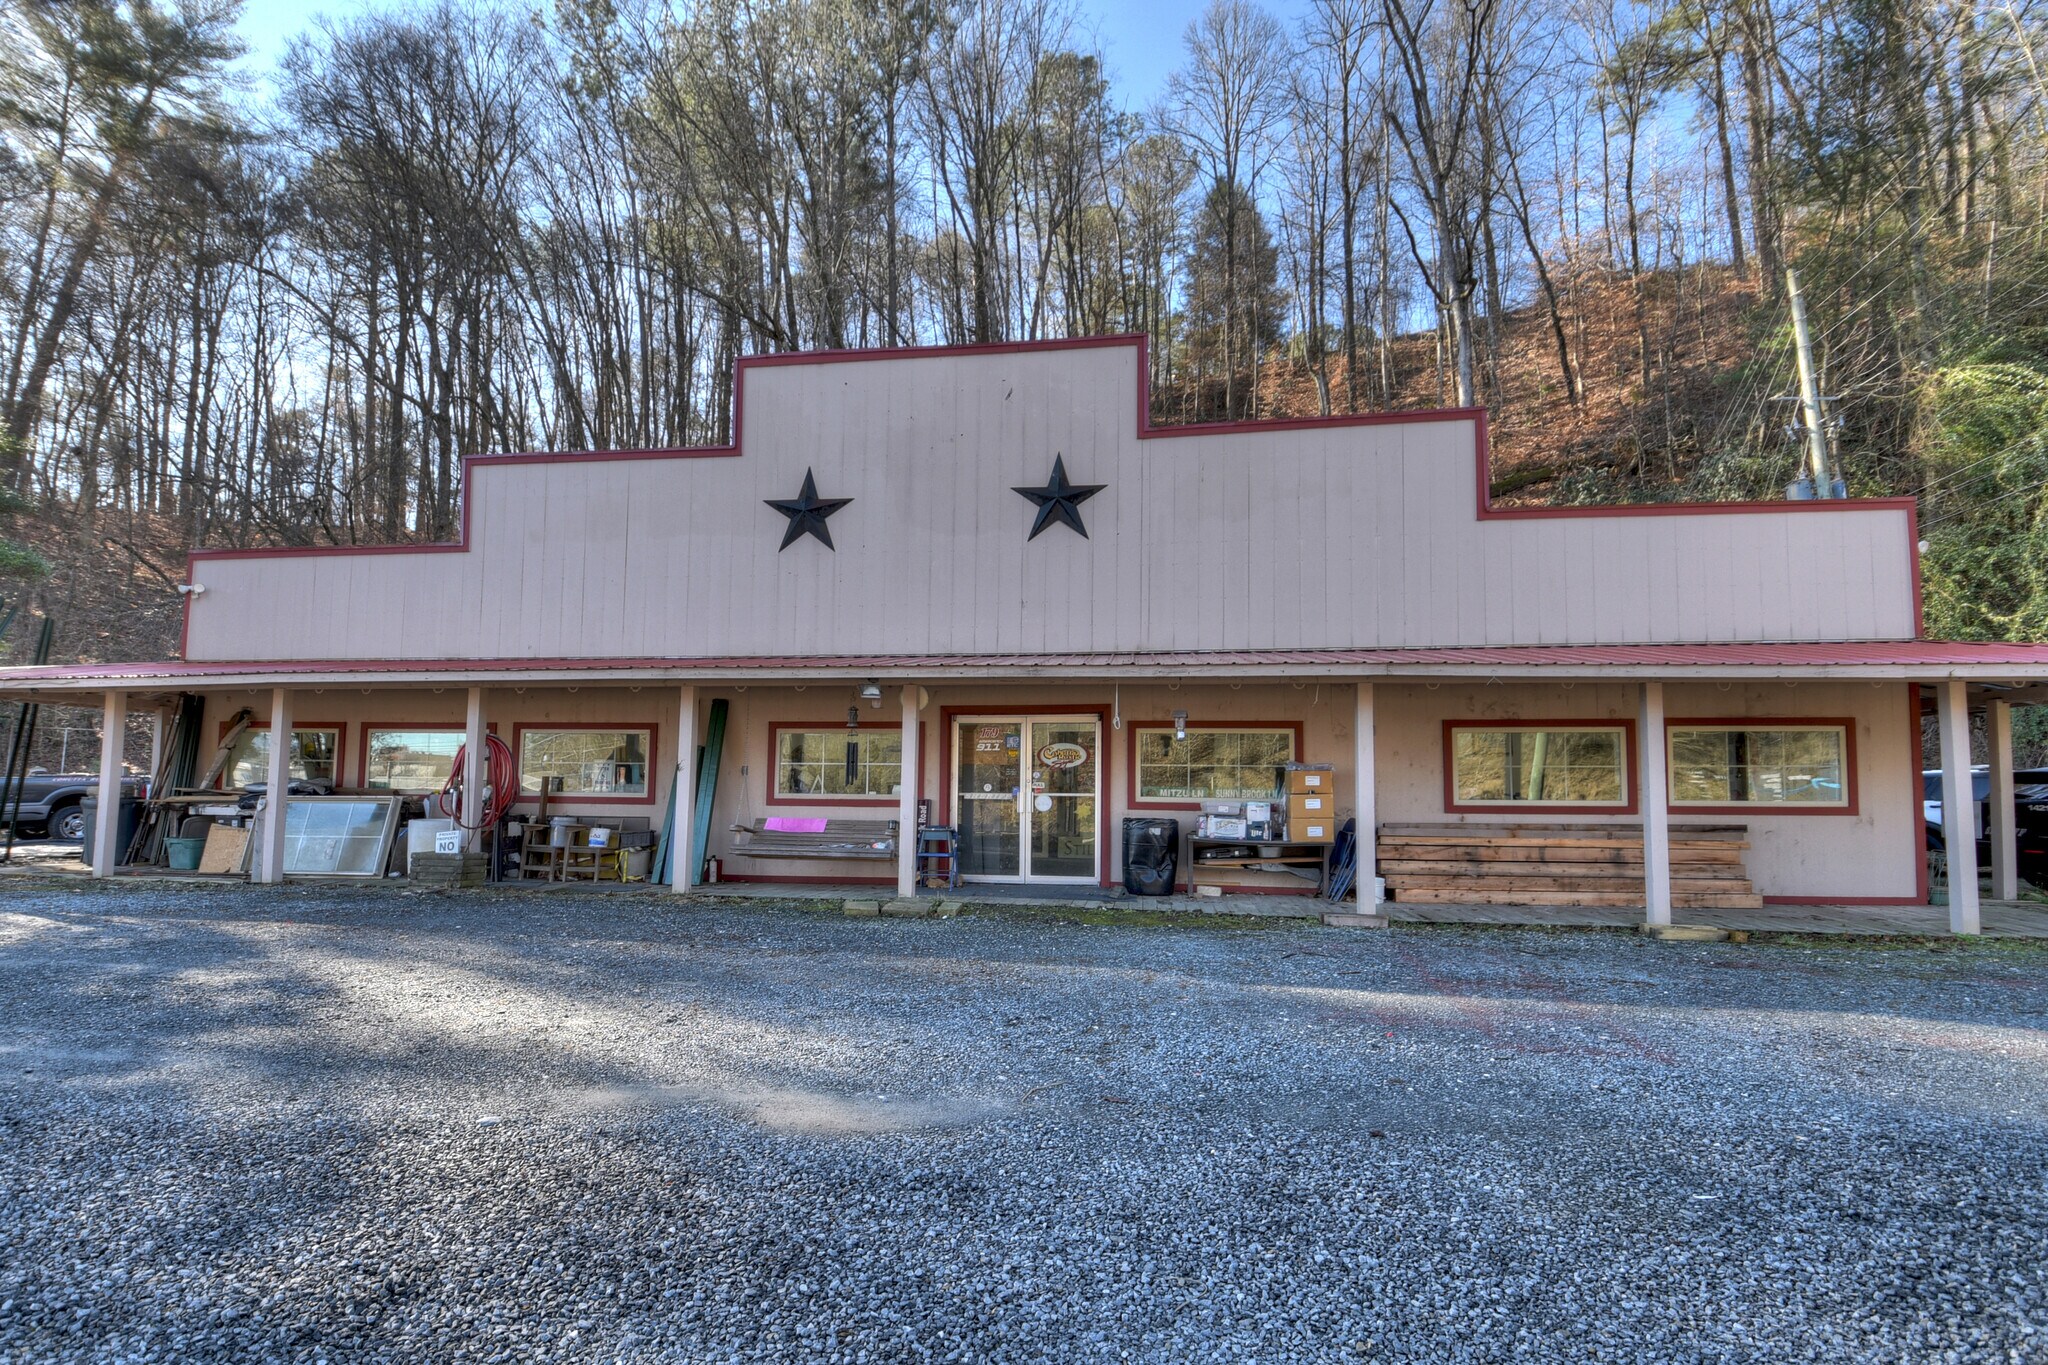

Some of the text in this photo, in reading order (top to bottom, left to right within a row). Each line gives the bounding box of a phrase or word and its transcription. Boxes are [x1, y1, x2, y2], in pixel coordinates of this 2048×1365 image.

[980, 728, 999, 738] 179
[1160, 789, 1204, 798] MITZU LN
[1215, 789, 1240, 798] SUNNY
[1241, 789, 1265, 799] BROOK
[918, 806, 927, 823] Road
[440, 842, 454, 851] NO
